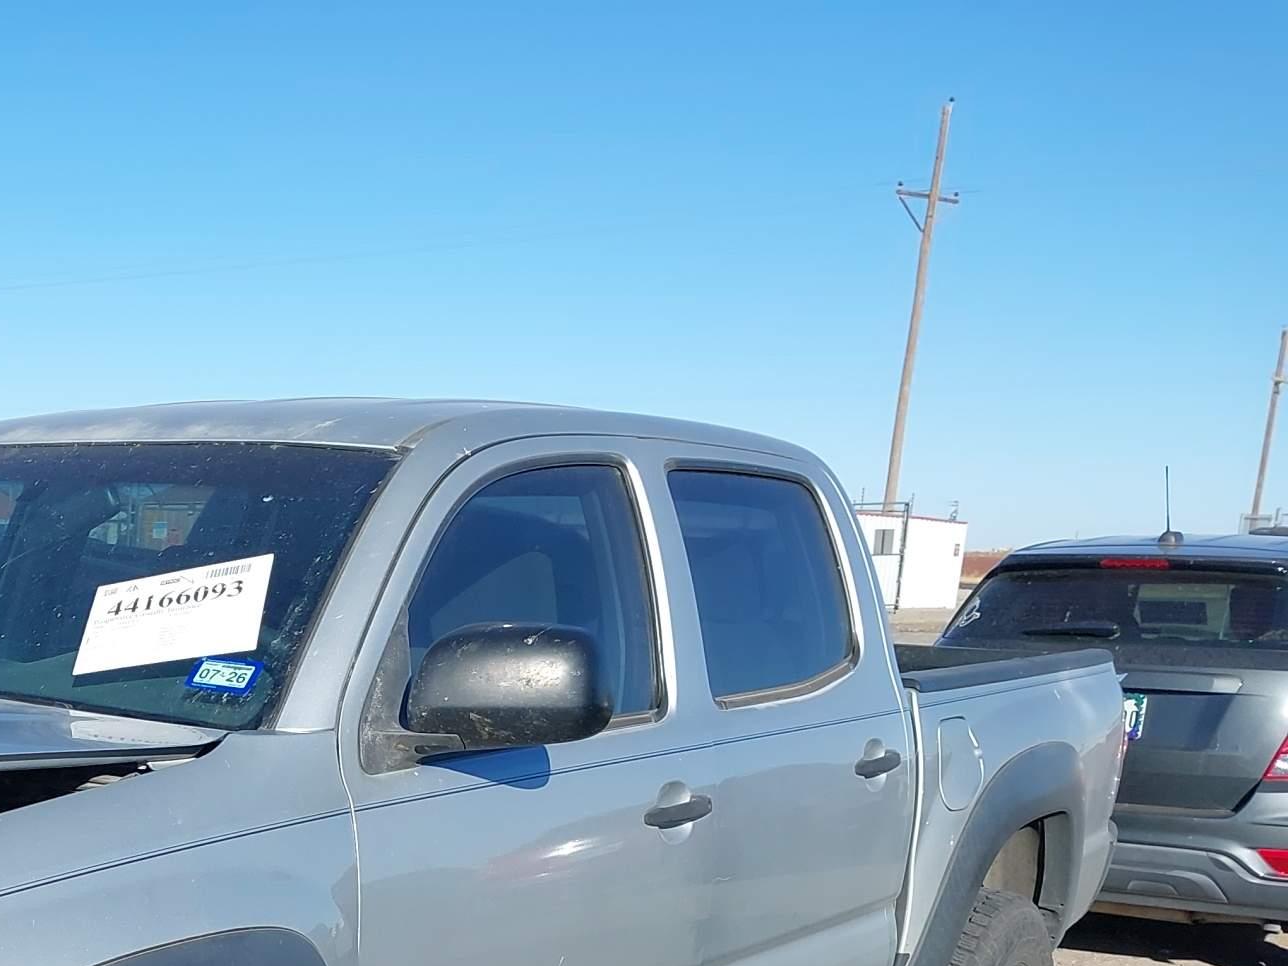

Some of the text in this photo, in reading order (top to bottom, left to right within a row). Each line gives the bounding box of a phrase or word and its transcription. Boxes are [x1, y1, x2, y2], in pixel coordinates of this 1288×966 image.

[106, 579, 244, 616] 44166093
[198, 668, 248, 684] 07 26
